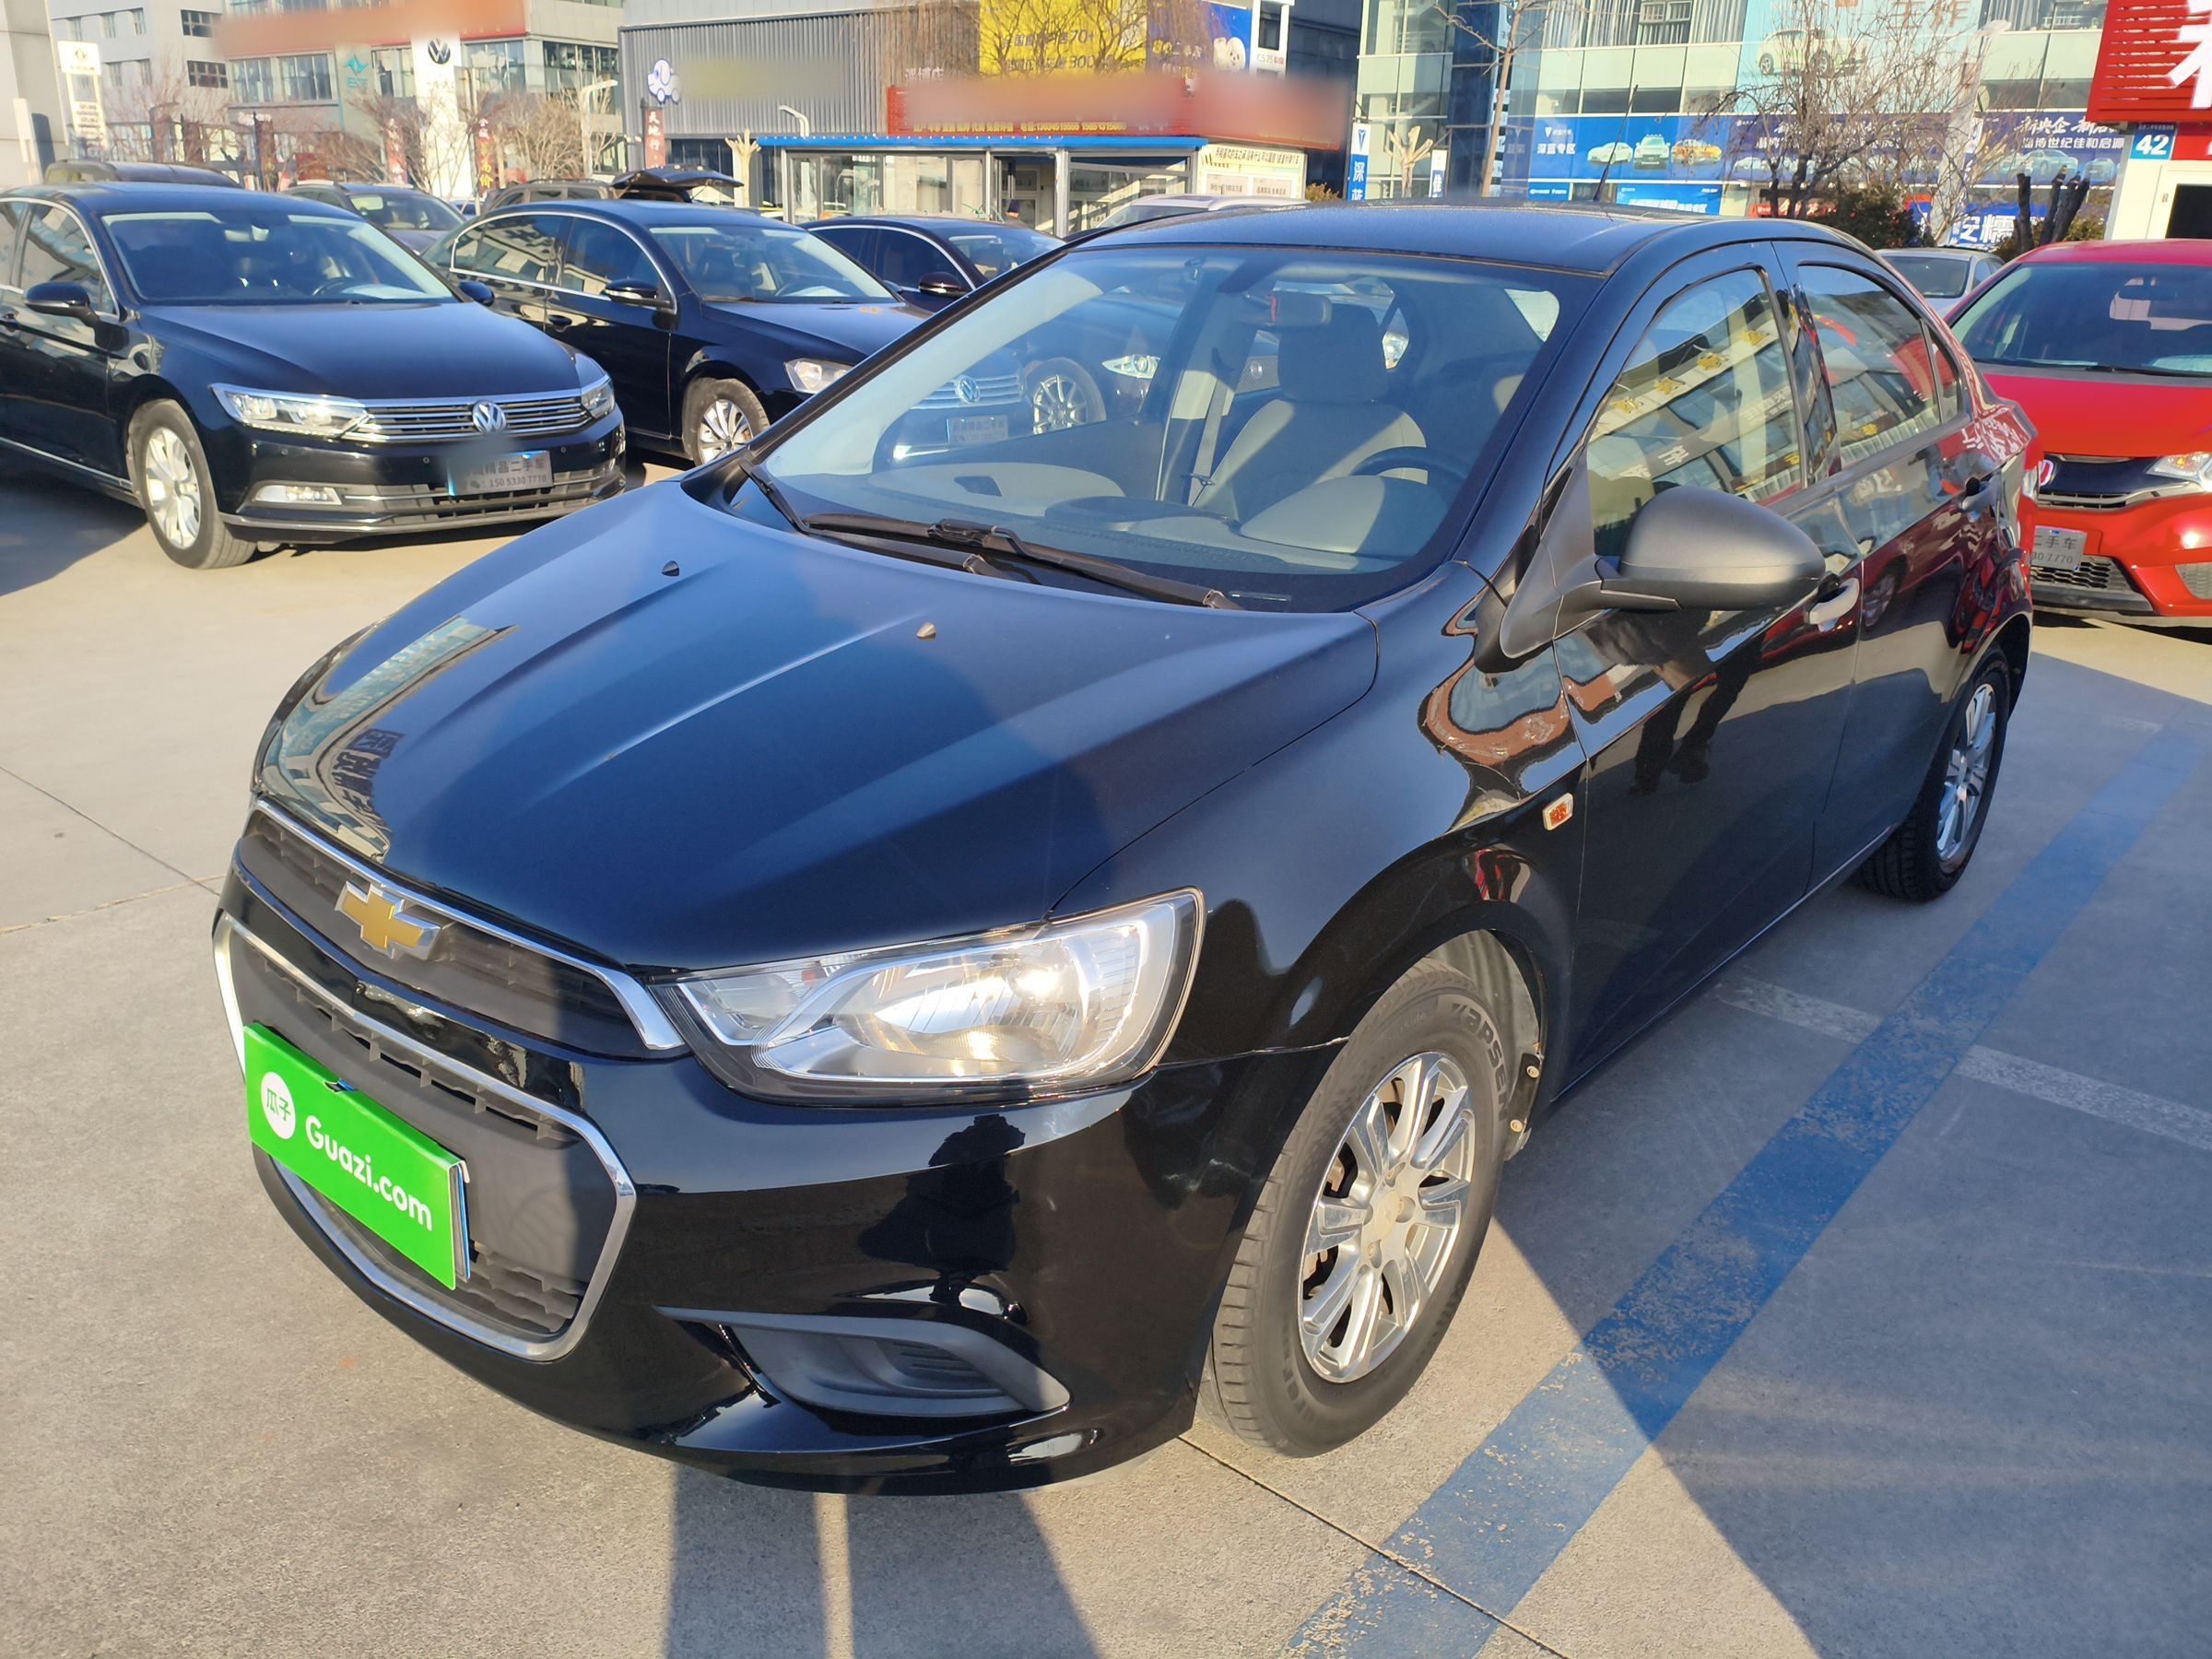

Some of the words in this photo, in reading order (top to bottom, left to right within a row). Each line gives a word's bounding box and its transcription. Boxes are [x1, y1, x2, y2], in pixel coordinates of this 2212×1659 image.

[2136, 135, 2170, 155] 42
[2033, 535, 2077, 550] 二手车
[265, 1088, 291, 1122] 瓜子
[305, 1114, 433, 1231] Guazi.com
